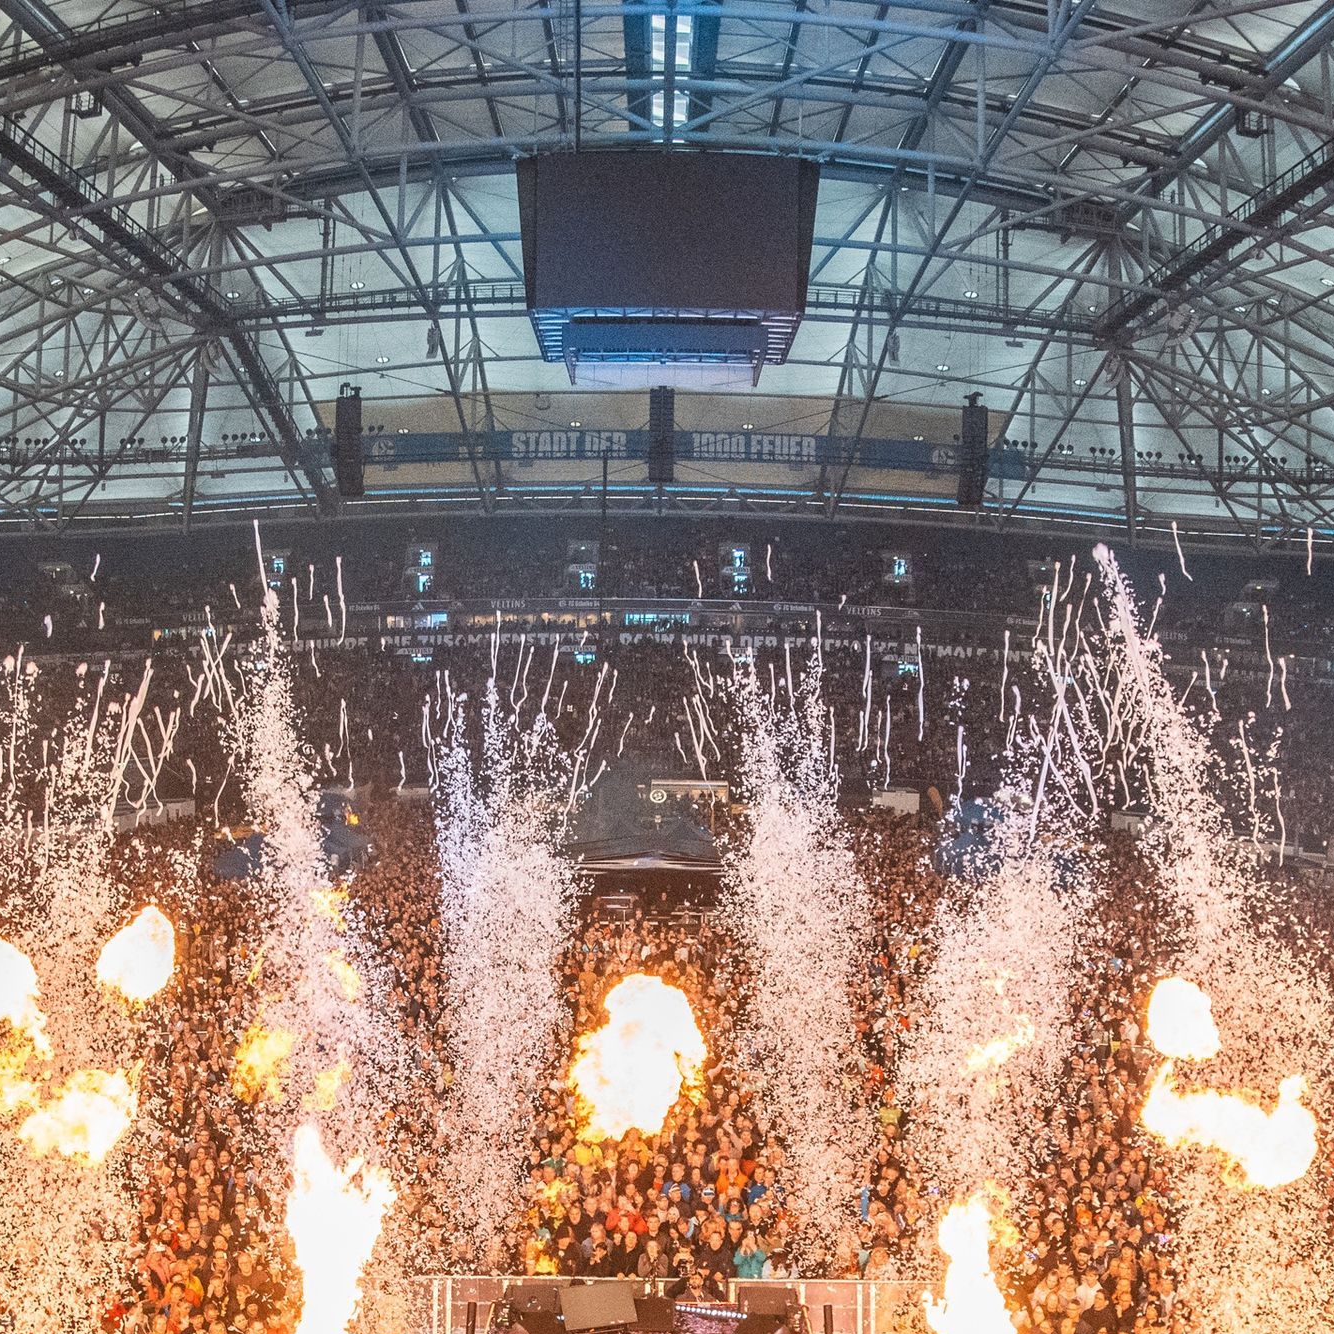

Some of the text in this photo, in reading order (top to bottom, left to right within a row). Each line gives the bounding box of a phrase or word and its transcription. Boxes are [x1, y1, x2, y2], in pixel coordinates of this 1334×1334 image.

[511, 431, 627, 458] STADT DER
[692, 433, 816, 461] 1000 FEUER
[182, 612, 216, 622] VELTIS
